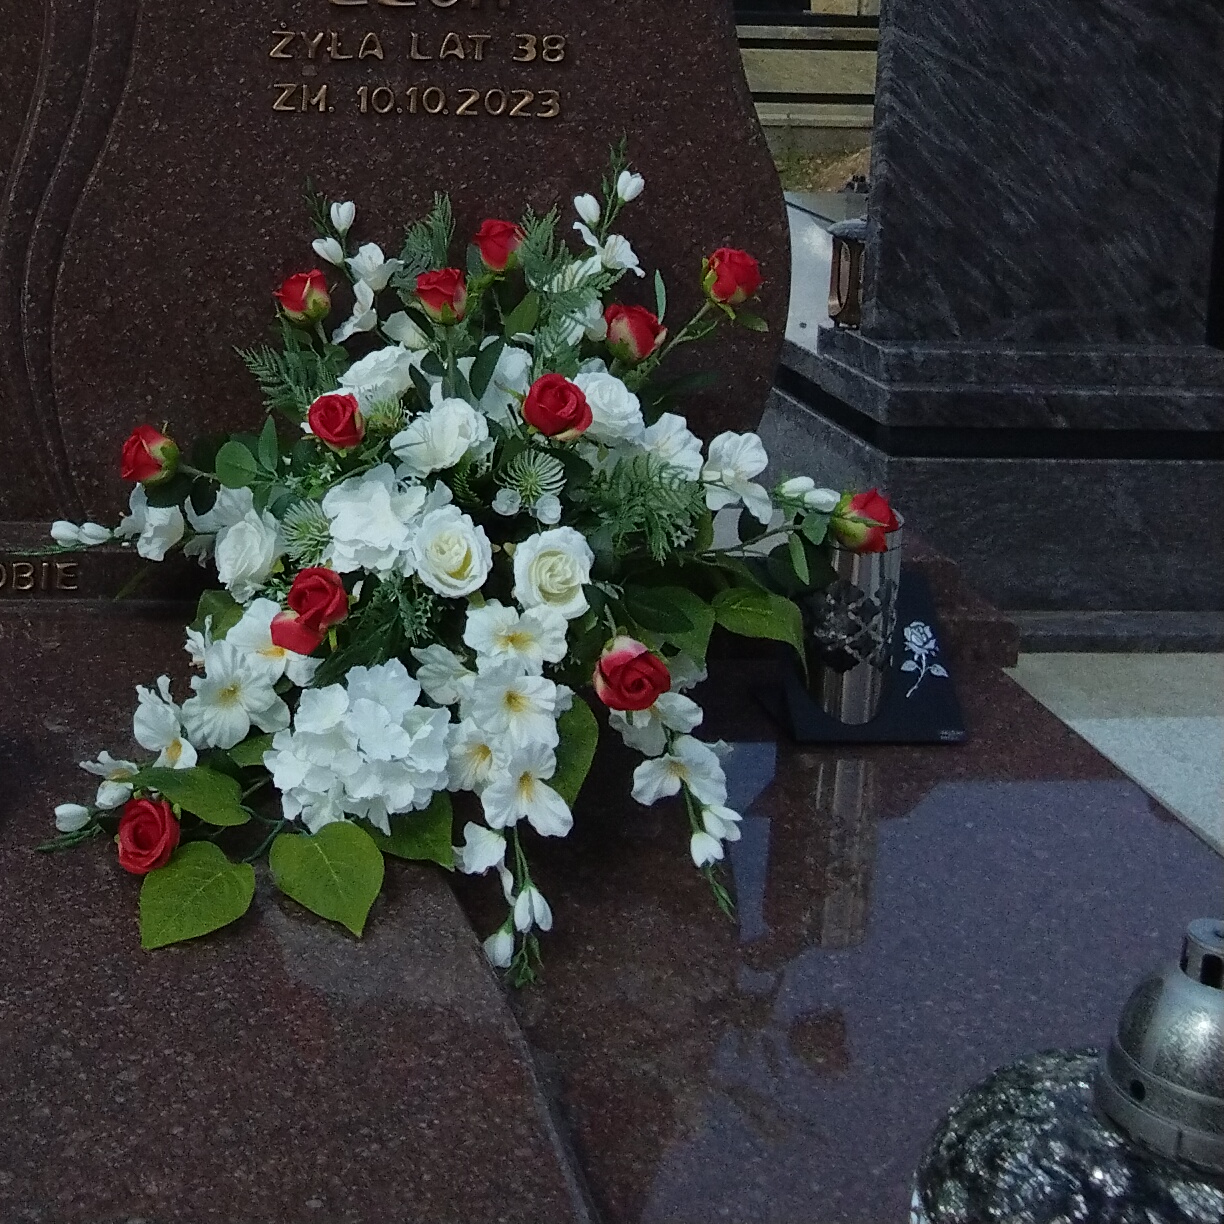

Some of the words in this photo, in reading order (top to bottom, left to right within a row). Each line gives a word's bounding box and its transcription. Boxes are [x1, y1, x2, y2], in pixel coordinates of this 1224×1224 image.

[269, 22, 384, 61] ŻYŁA
[410, 31, 492, 61] LAT
[512, 34, 566, 63] 38
[272, 83, 336, 113] ZM.
[356, 85, 561, 118] 10.10.2023
